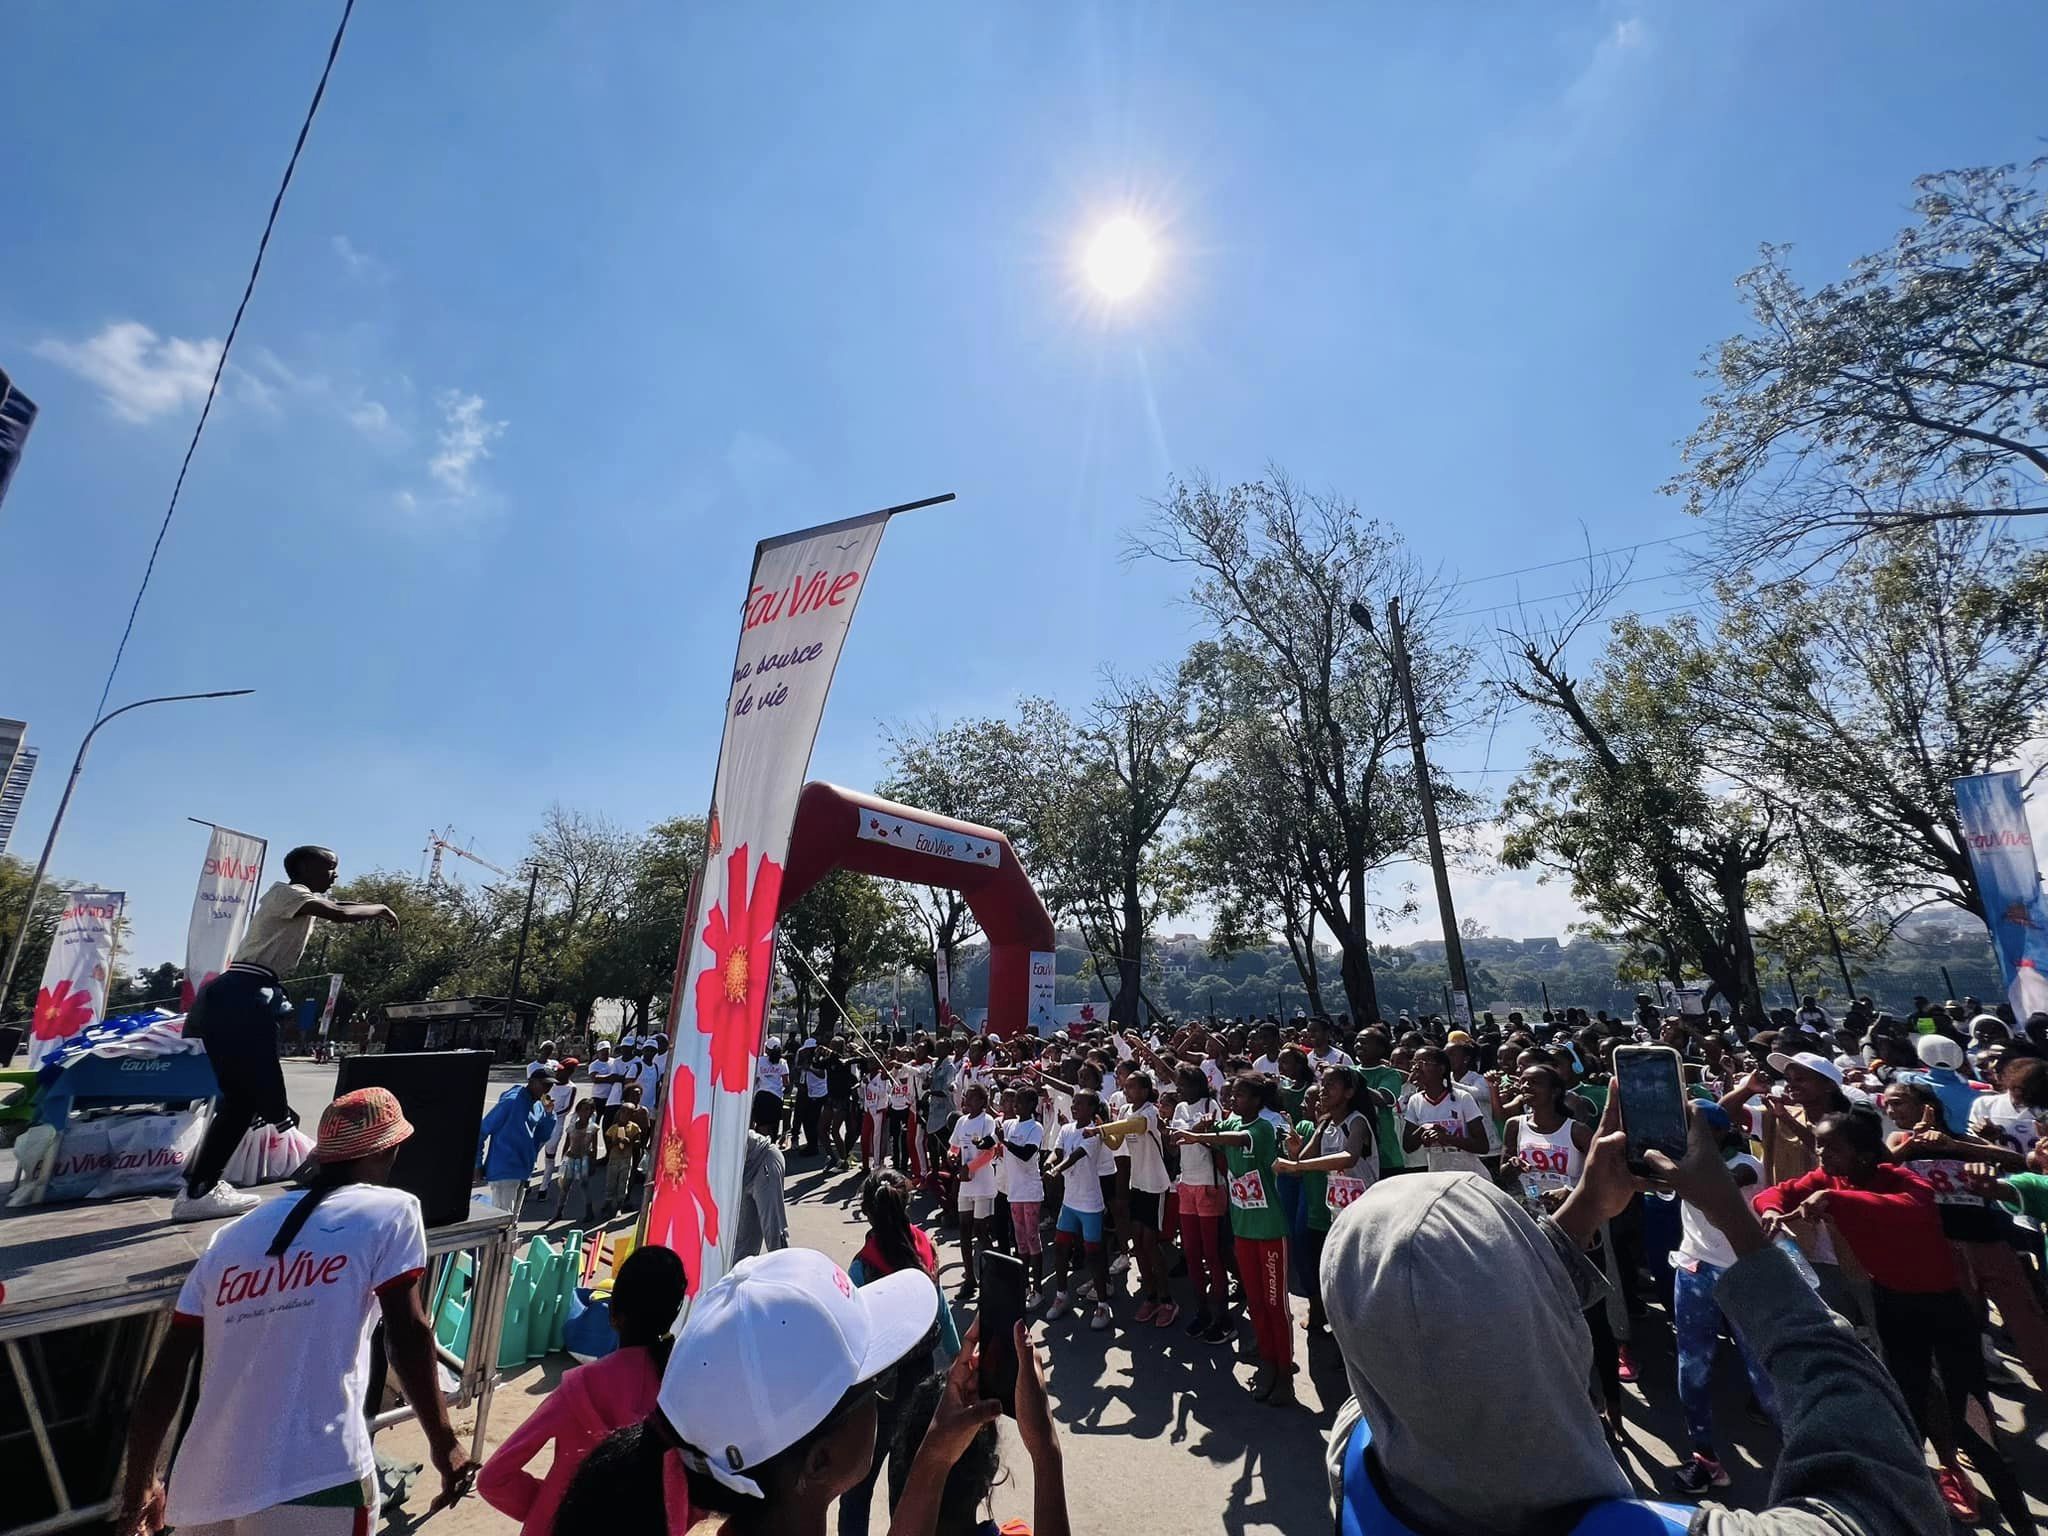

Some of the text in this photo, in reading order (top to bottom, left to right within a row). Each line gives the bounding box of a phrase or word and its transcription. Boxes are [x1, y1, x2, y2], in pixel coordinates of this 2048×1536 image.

[756, 642, 823, 675] source
[733, 682, 788, 718] de vie
[1265, 1250, 1279, 1307] Supreme
